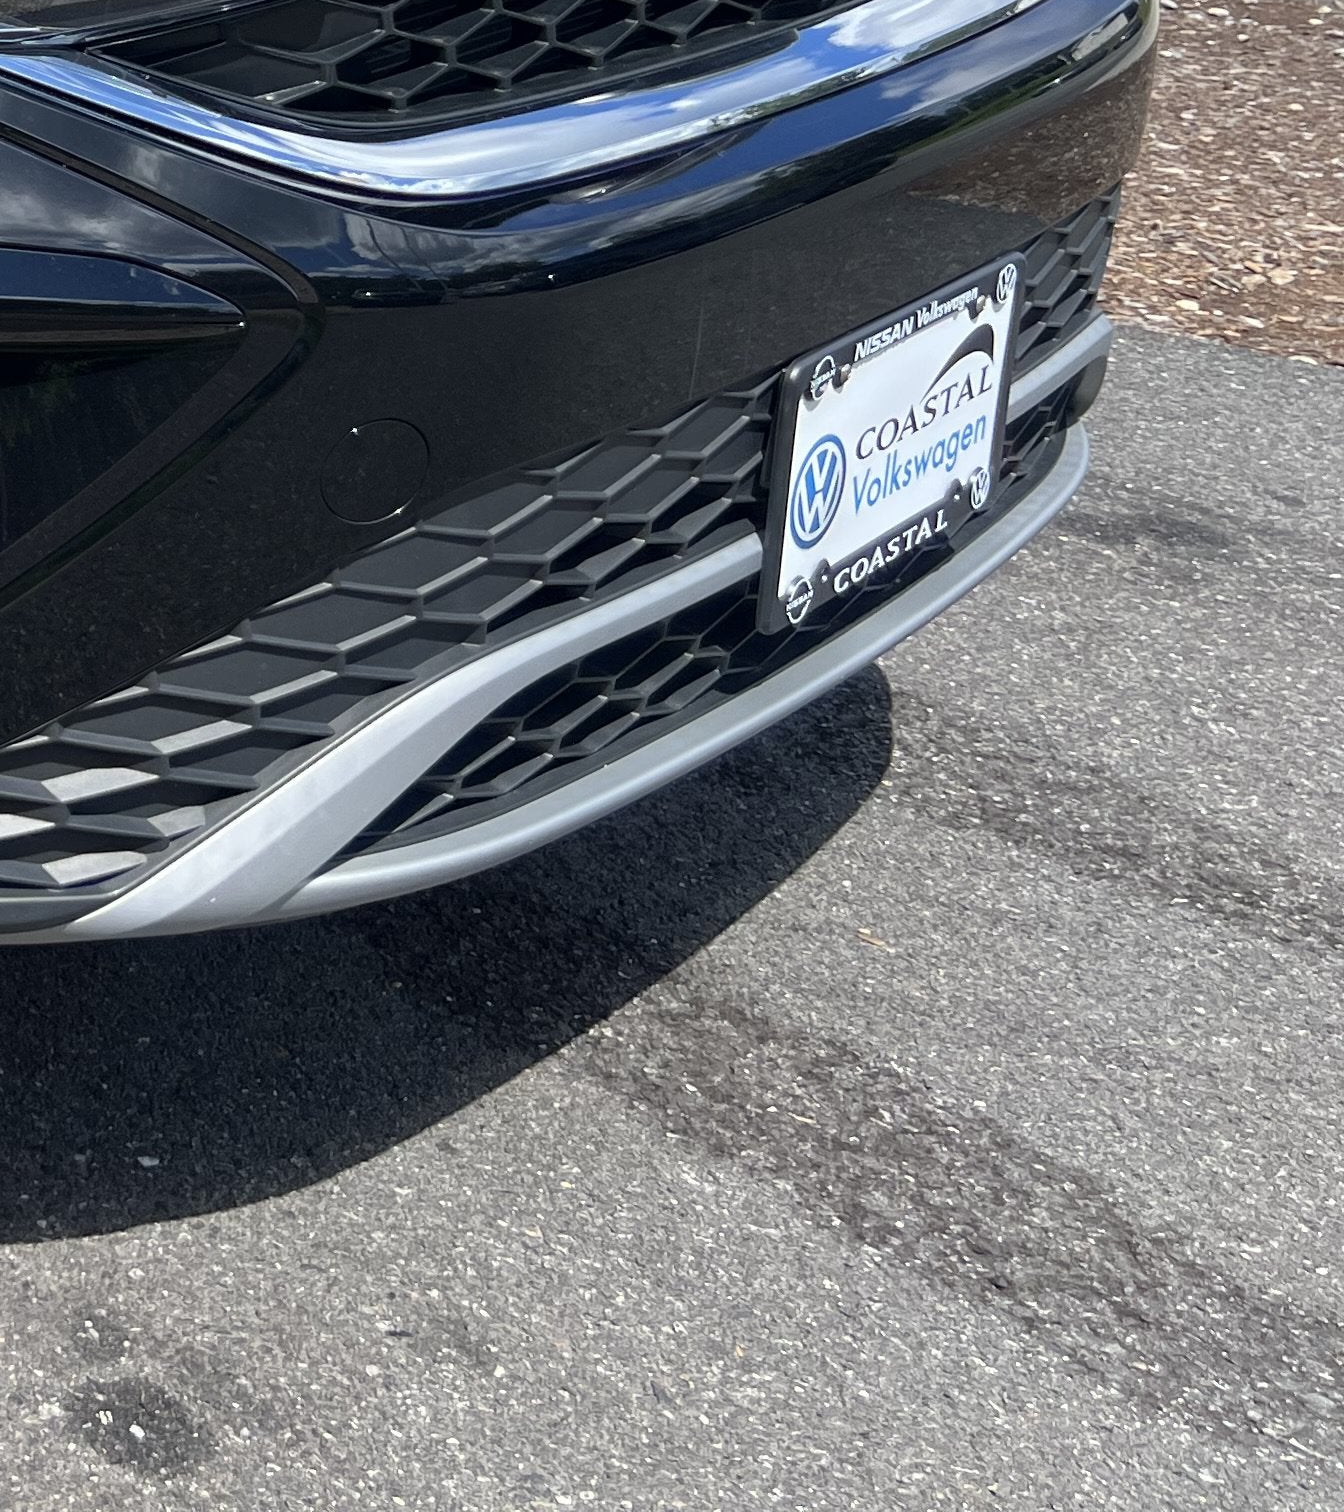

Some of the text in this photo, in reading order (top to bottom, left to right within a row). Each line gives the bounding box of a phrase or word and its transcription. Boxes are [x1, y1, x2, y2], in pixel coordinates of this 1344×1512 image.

[853, 287, 979, 362] NISSAN Volkswagen
[855, 364, 993, 460] COASTAL
[853, 414, 987, 516] Volkswagen
[833, 508, 948, 594] COASTAL
